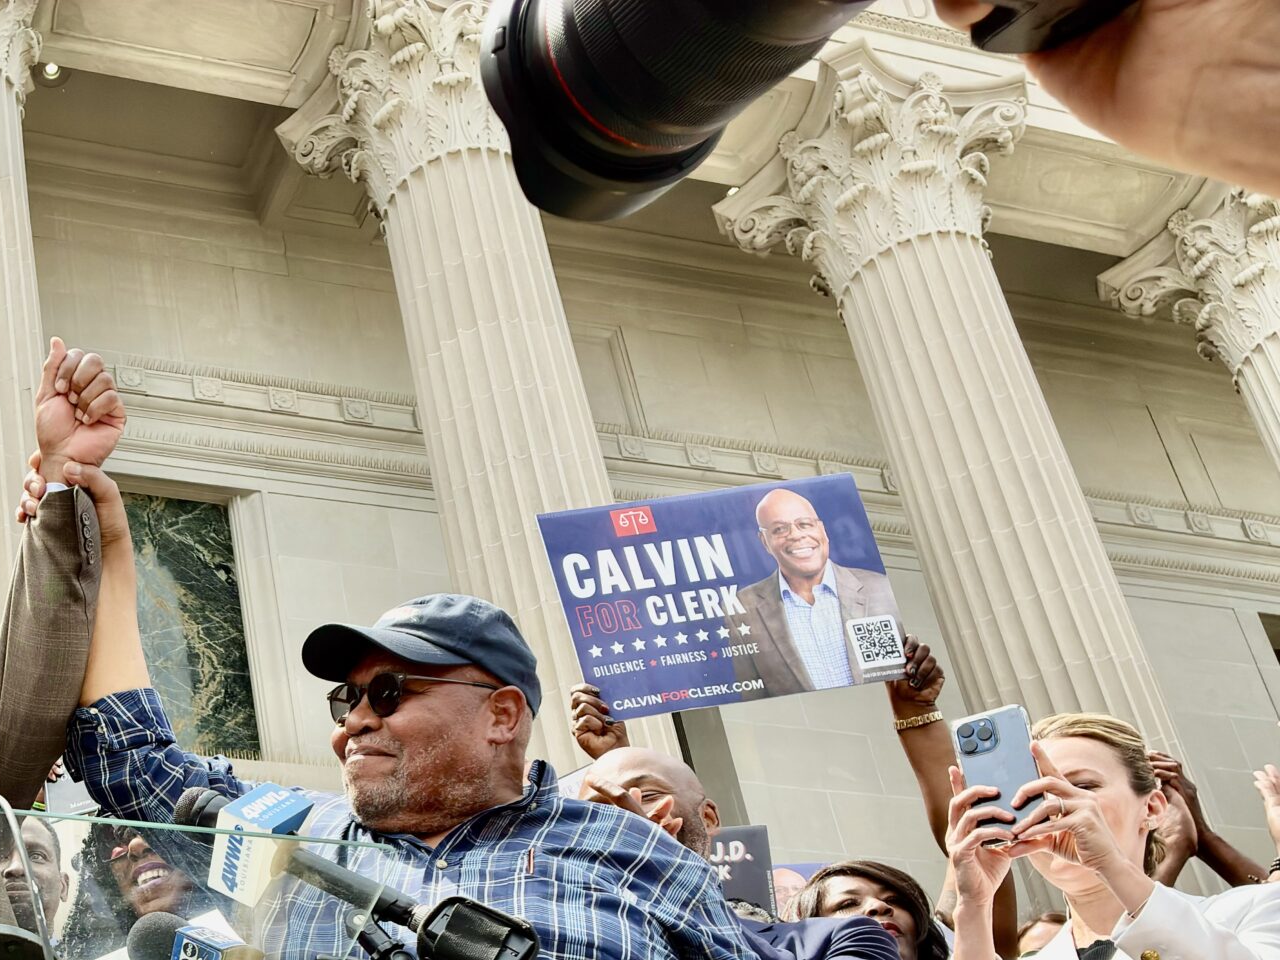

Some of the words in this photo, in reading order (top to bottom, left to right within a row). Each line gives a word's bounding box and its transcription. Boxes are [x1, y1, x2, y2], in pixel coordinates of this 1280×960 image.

[562, 534, 734, 598] CALVIN
[576, 600, 642, 637] FOR
[645, 584, 746, 626] CLERK
[593, 659, 646, 678] DILIGENCE
[660, 650, 708, 667] FAIRNESS
[721, 642, 760, 659] JUSTICE
[613, 678, 765, 711] CALVINFORCLERK.COM
[241, 791, 283, 820] 4WWL
